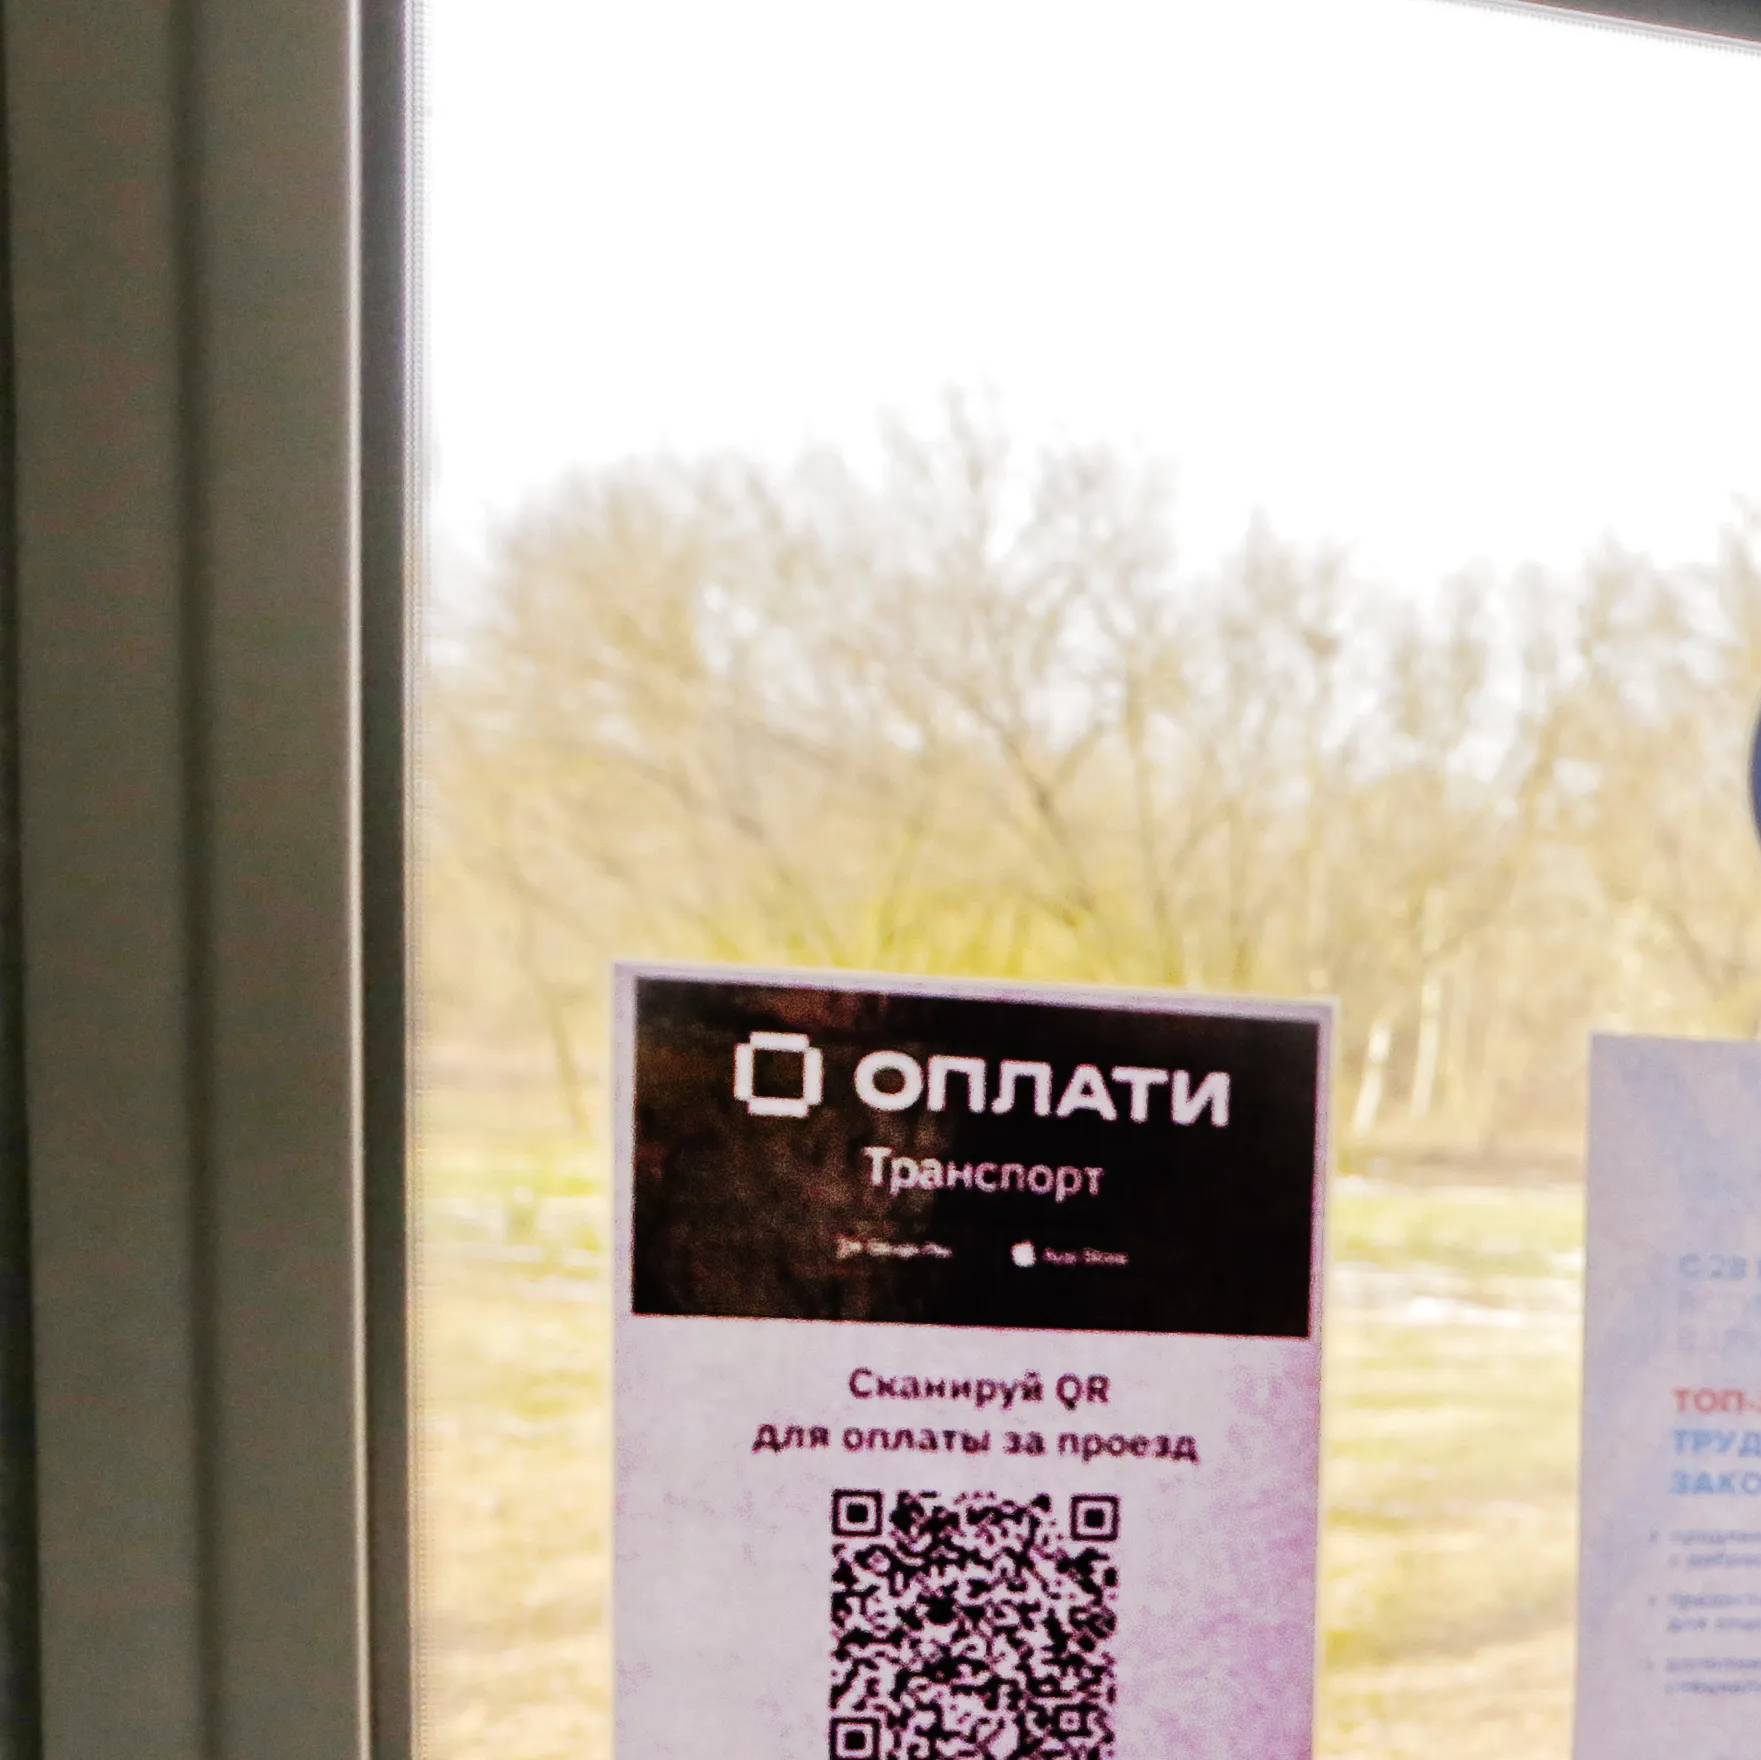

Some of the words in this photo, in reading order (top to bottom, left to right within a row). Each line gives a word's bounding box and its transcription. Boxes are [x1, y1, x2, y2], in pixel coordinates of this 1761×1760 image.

[854, 1050, 1230, 1127] ОПЛАТИ
[863, 1146, 1104, 1202] Транспорт
[848, 1366, 1044, 1410] Сканируй
[1055, 1372, 1111, 1410] QR
[751, 1422, 830, 1454] для
[843, 1425, 992, 1455] оплаты
[1003, 1430, 1045, 1457] за
[1057, 1431, 1199, 1463] проезд
